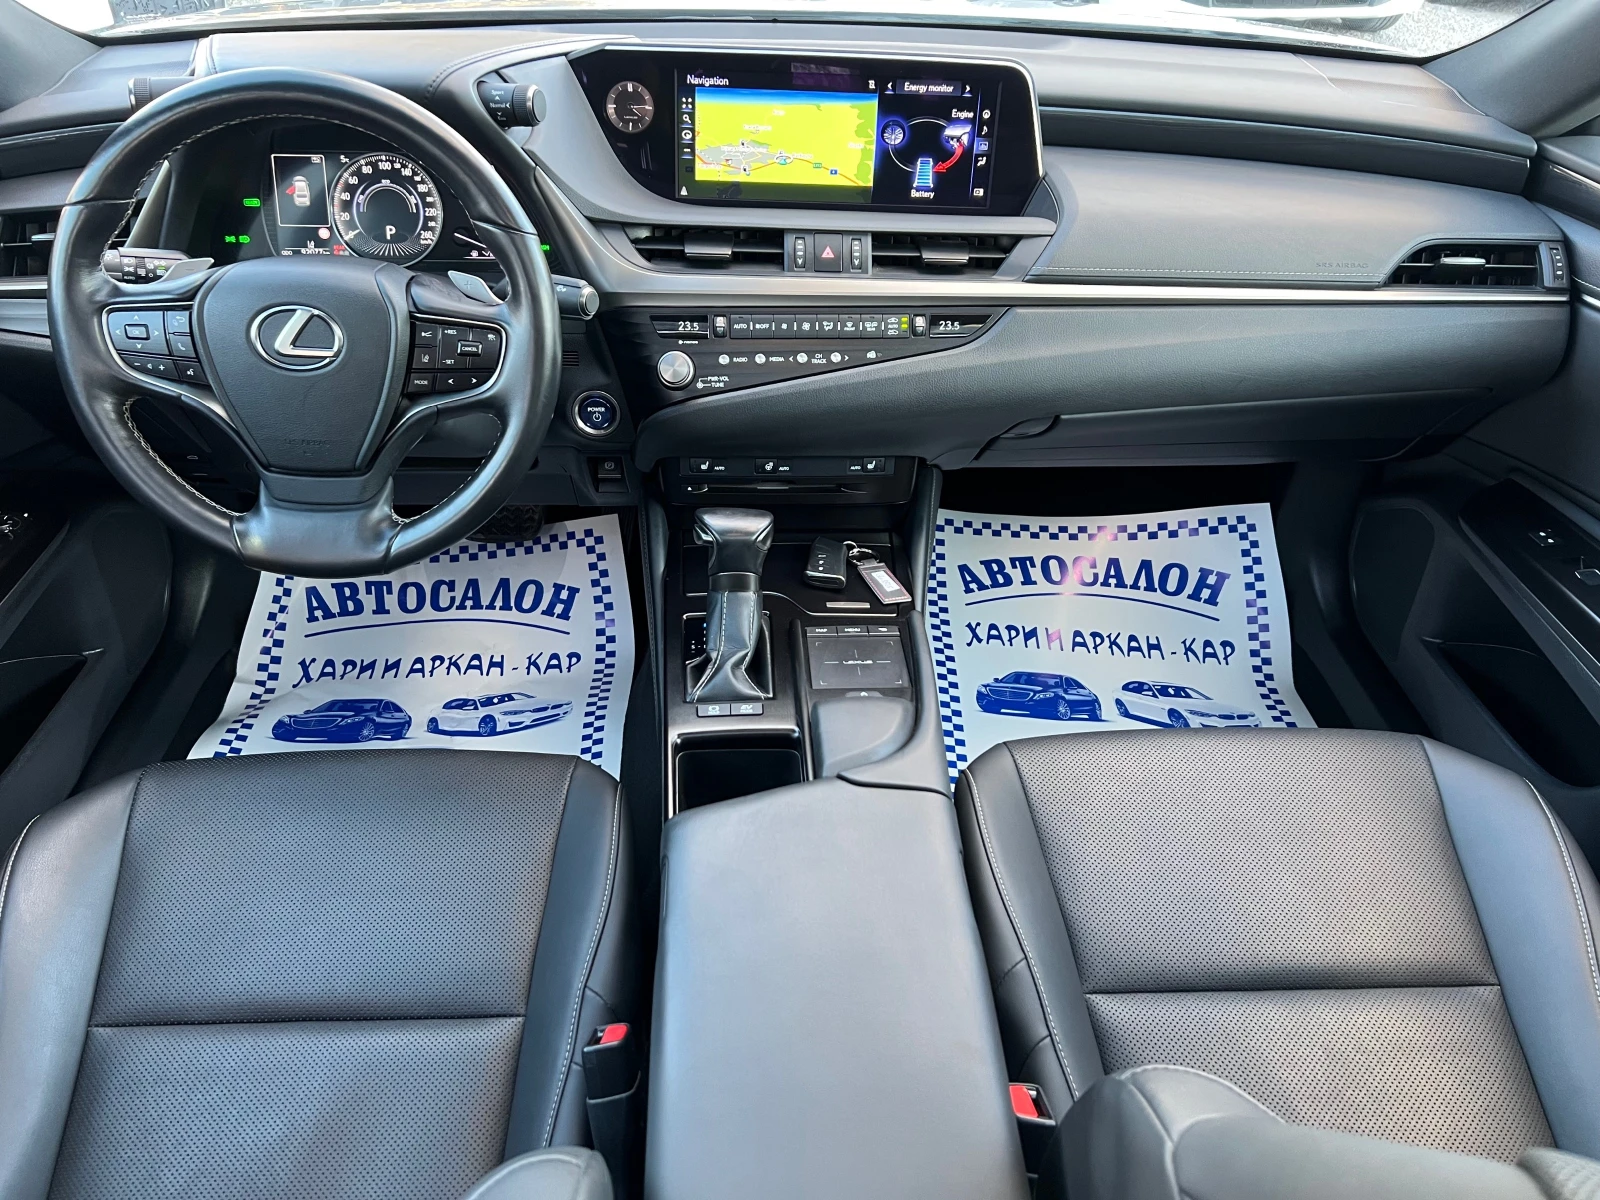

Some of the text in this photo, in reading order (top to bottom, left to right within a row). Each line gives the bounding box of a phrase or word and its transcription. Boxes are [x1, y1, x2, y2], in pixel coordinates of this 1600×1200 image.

[686, 74, 729, 87] Navigation
[904, 81, 954, 93] Energy monitor
[951, 108, 974, 119] Engine
[361, 165, 372, 174] 80
[378, 161, 392, 170] 100
[401, 167, 413, 176] 140
[348, 175, 359, 185] 60
[416, 183, 429, 193] 180
[340, 192, 351, 201] 40
[911, 189, 935, 199] Battery
[340, 212, 350, 221] 20
[424, 208, 437, 217] 220
[385, 225, 397, 240] P
[420, 230, 433, 240] 260
[678, 321, 700, 331] 23.5
[939, 320, 960, 331] 23.5
[769, 355, 785, 363] MEDIA
[957, 555, 1231, 607] АВТОСАЛОН
[305, 577, 580, 624] АВТОСАЛОН
[965, 621, 1041, 650] ХАРИ
[1071, 629, 1166, 660] АРКАН
[1181, 638, 1237, 666] КАР
[292, 657, 378, 689] ХАРИ
[405, 653, 506, 679] АРКАН
[525, 651, 582, 676] КАР
